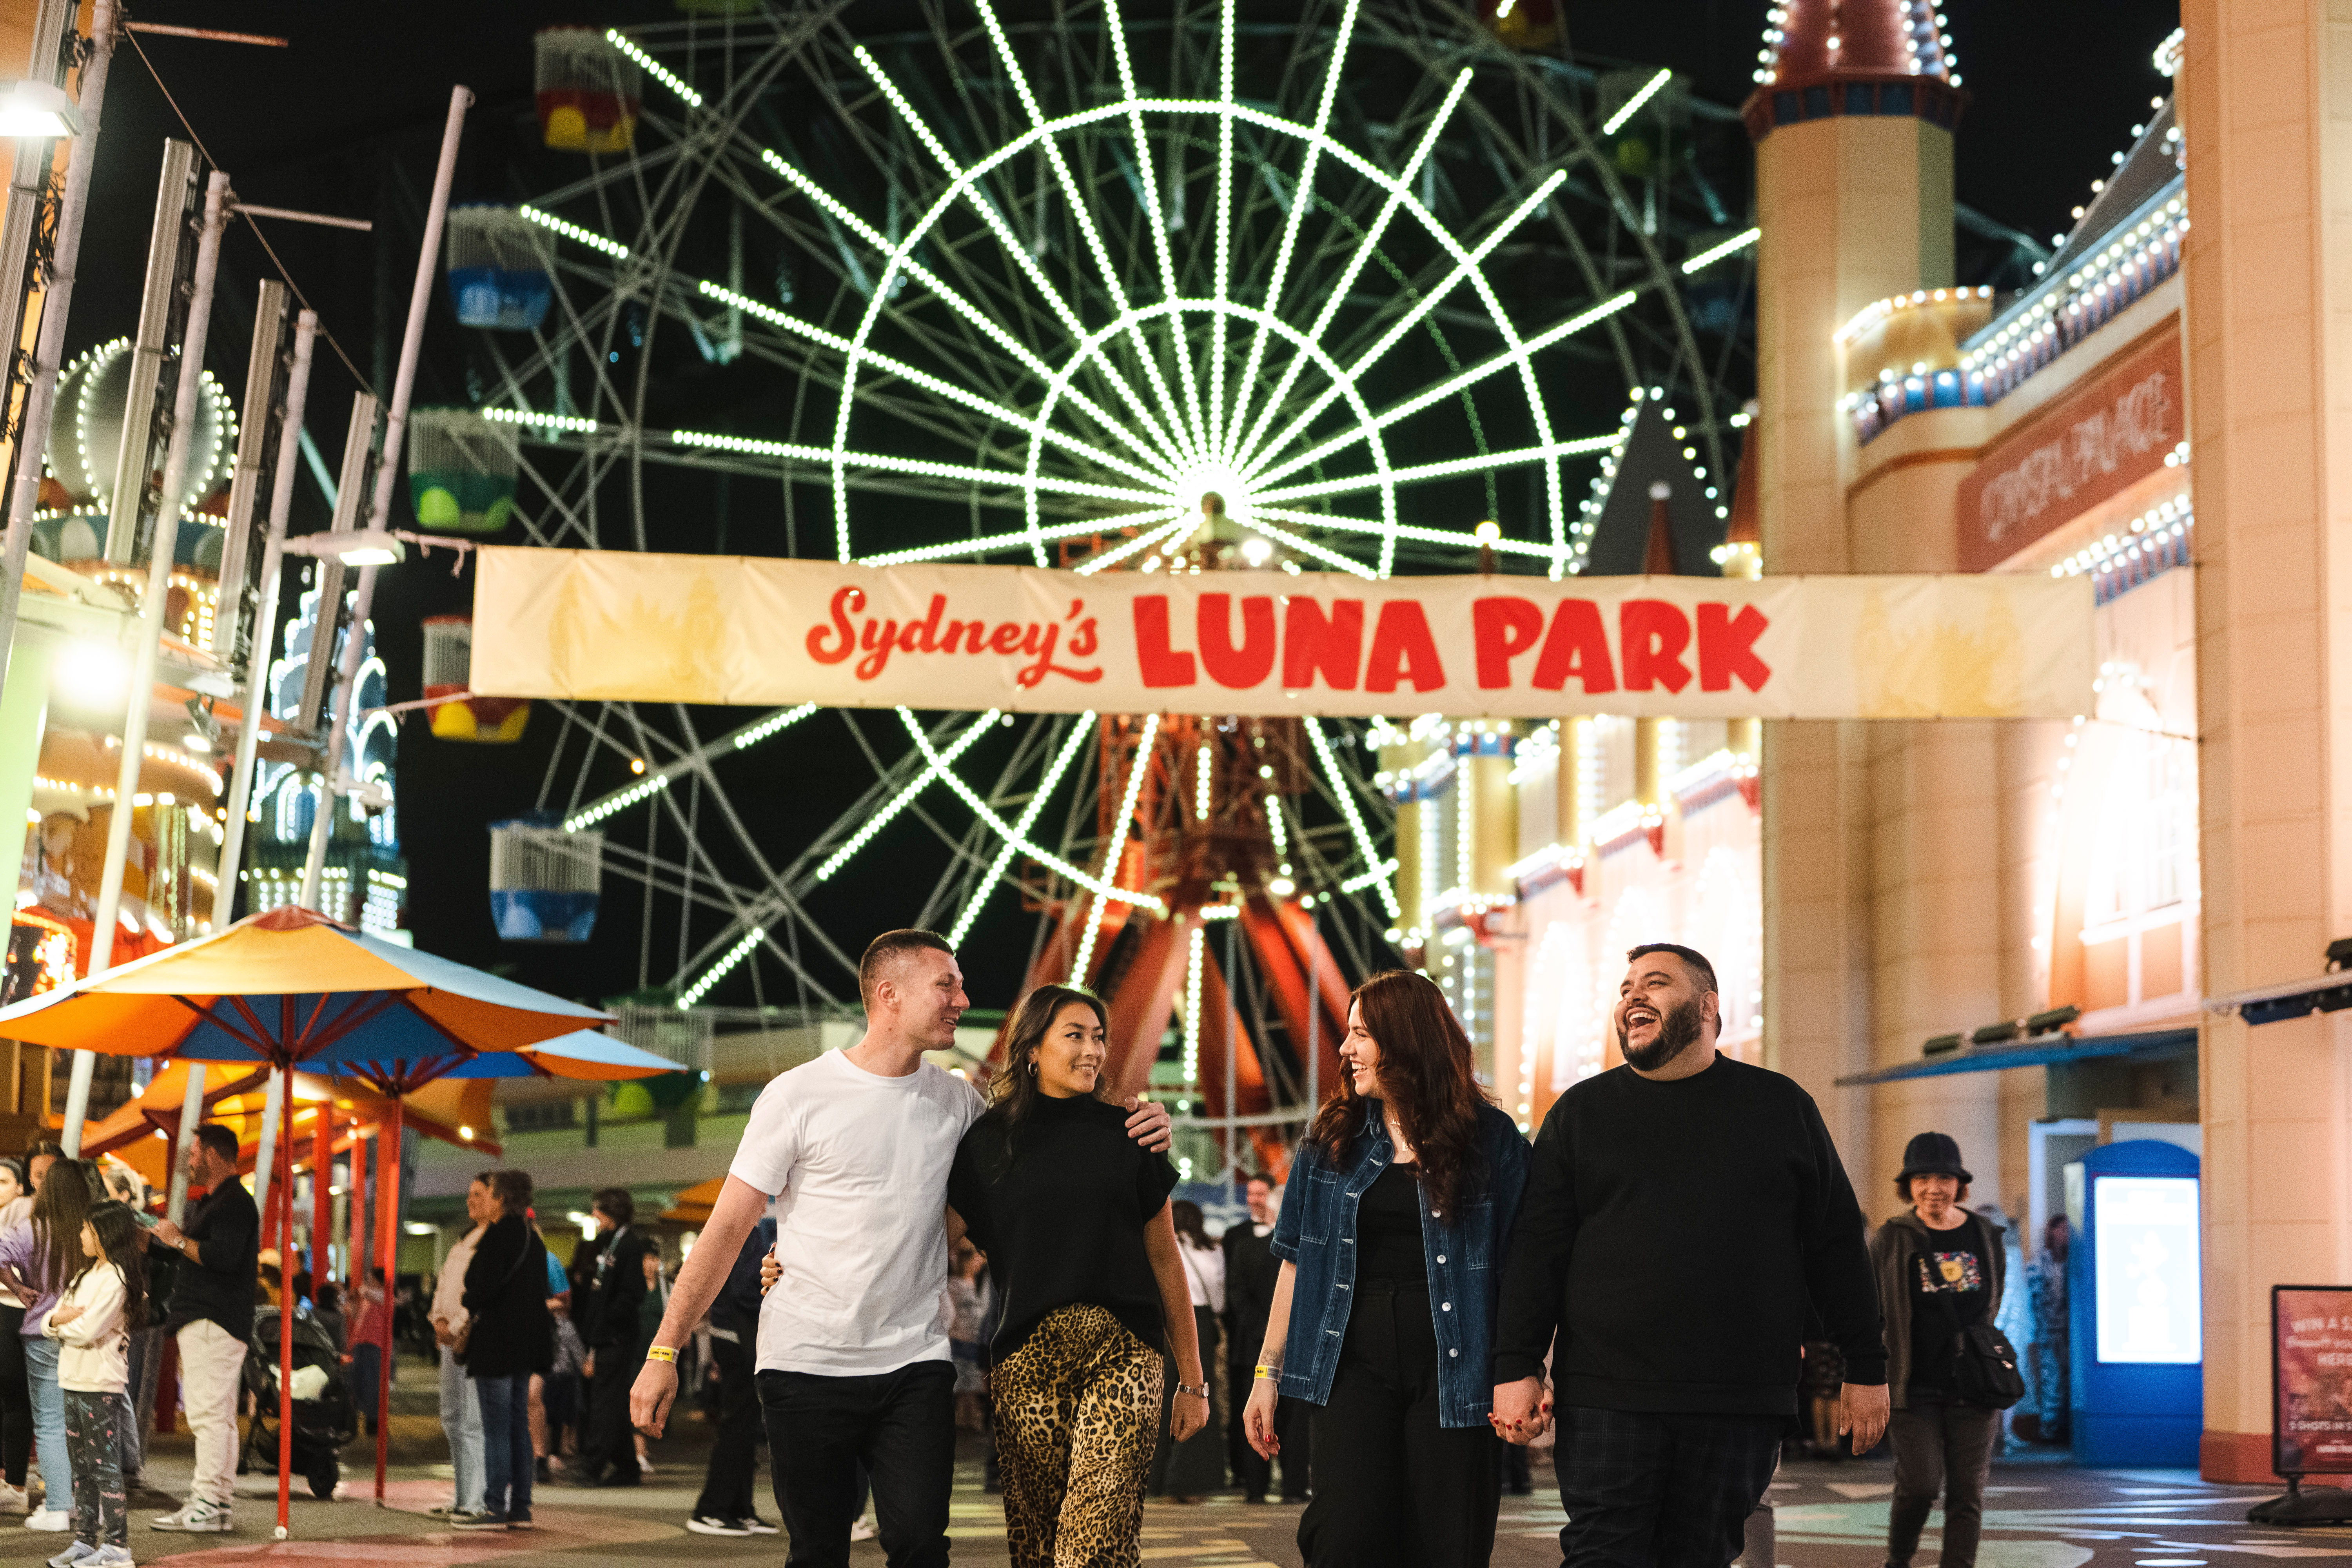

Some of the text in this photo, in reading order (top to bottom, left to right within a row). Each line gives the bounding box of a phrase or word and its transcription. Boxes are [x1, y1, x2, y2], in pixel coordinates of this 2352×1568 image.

[805, 586, 1771, 695] Sydney's LUNA PARK
[2291, 1318, 2324, 1332] WIN
[2326, 1316, 2339, 1330] A
